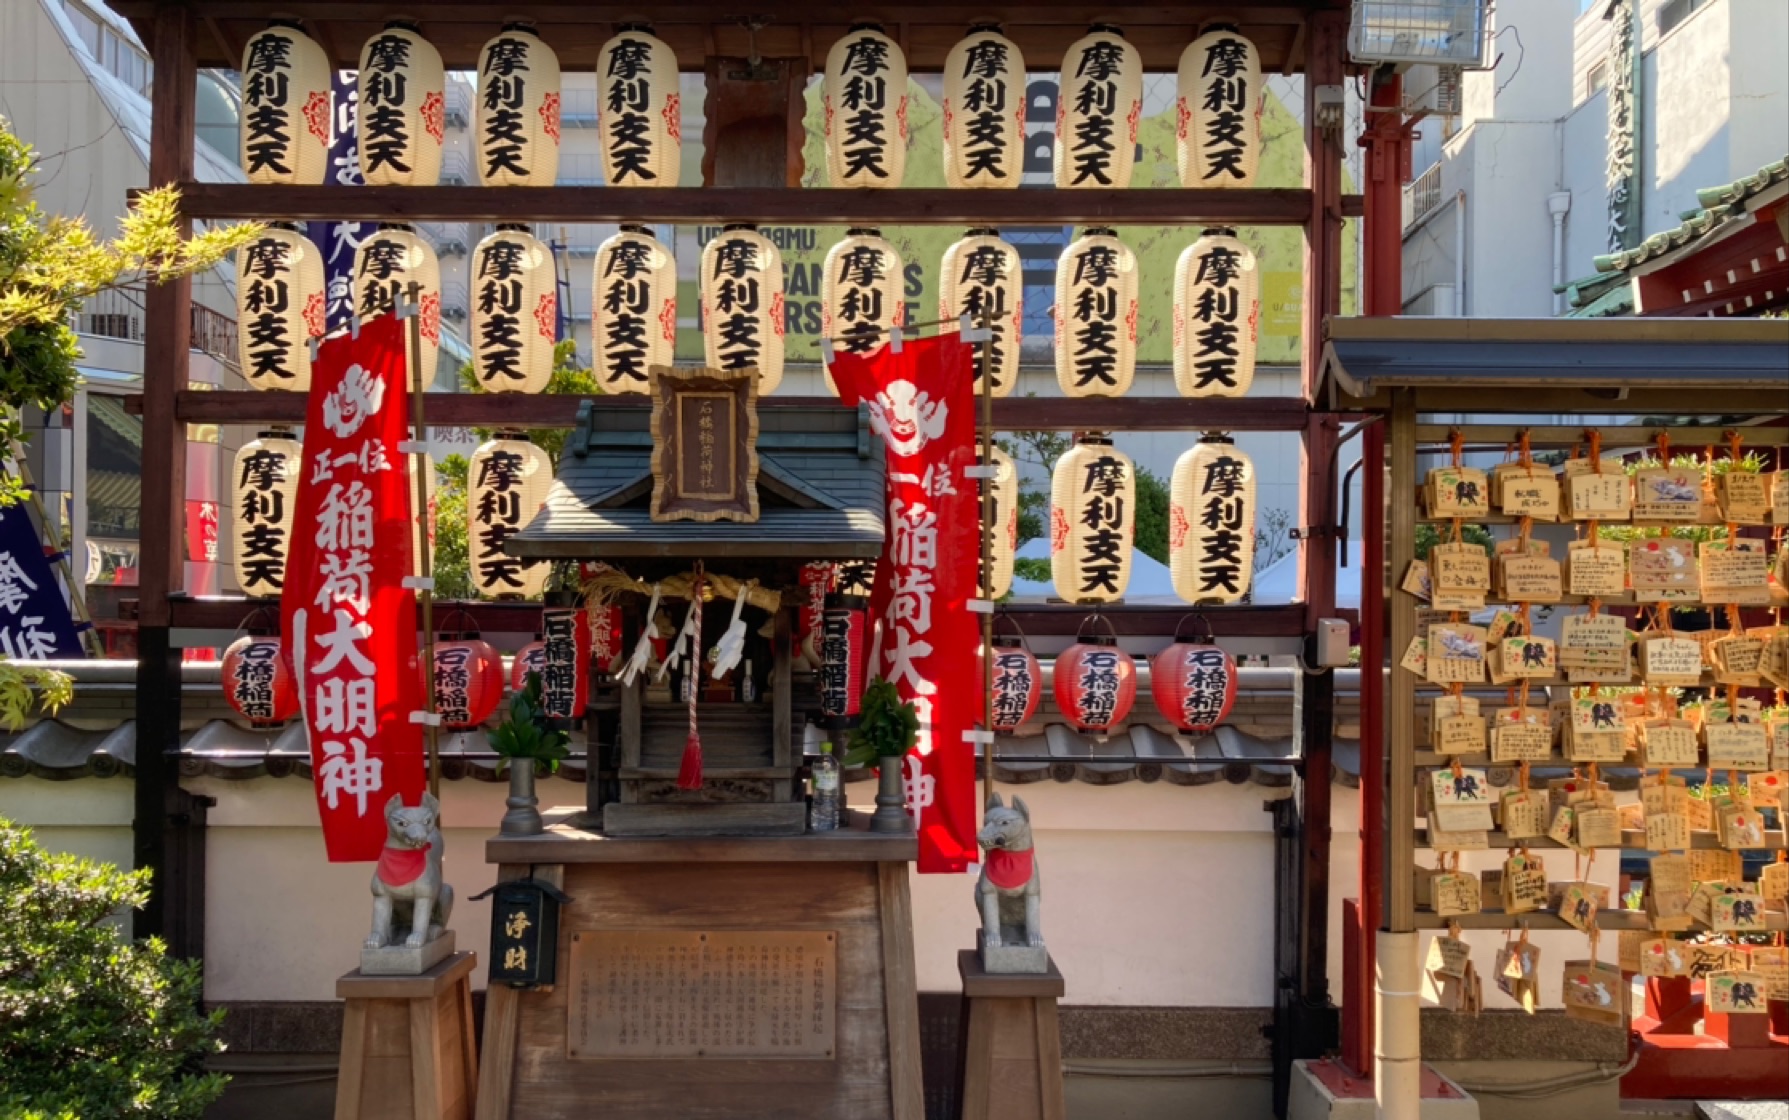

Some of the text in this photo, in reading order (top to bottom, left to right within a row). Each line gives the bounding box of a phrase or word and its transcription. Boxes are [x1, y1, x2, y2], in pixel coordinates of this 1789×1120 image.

[246, 33, 294, 174] 摩利支天
[365, 33, 413, 173] 摩利支天
[483, 38, 531, 178] 摩利支天
[606, 38, 656, 183] 摩利支天
[841, 37, 890, 179] 摩利支天
[963, 39, 1011, 179] 摩利支天
[1073, 41, 1125, 185] 摩利支天
[1200, 38, 1248, 180] 摩利支天
[244, 239, 295, 378] 摩利支天
[477, 240, 526, 381] 摩利支天
[603, 239, 656, 382] 摩利支天
[838, 246, 886, 353] 摩利支
[1072, 246, 1118, 386] 摩利支天
[1193, 247, 1240, 388] 摩利支天
[239, 450, 285, 588] 摩利支天
[310, 439, 391, 486] 正一位
[887, 463, 957, 498] 一位
[1081, 456, 1126, 594] 摩利支天
[1199, 456, 1245, 594] 摩利支天
[234, 640, 280, 719] 石橋稲荷
[311, 482, 384, 818] 稲荷大明神
[433, 645, 472, 723] 石橋稲荷
[544, 610, 576, 717] 石橋稲荷
[823, 610, 851, 715] 石橋稲荷
[994, 652, 1030, 726] 石橋稲荷
[1080, 651, 1120, 726] 石橋稲荷
[1187, 650, 1228, 726] 石橋稲荷
